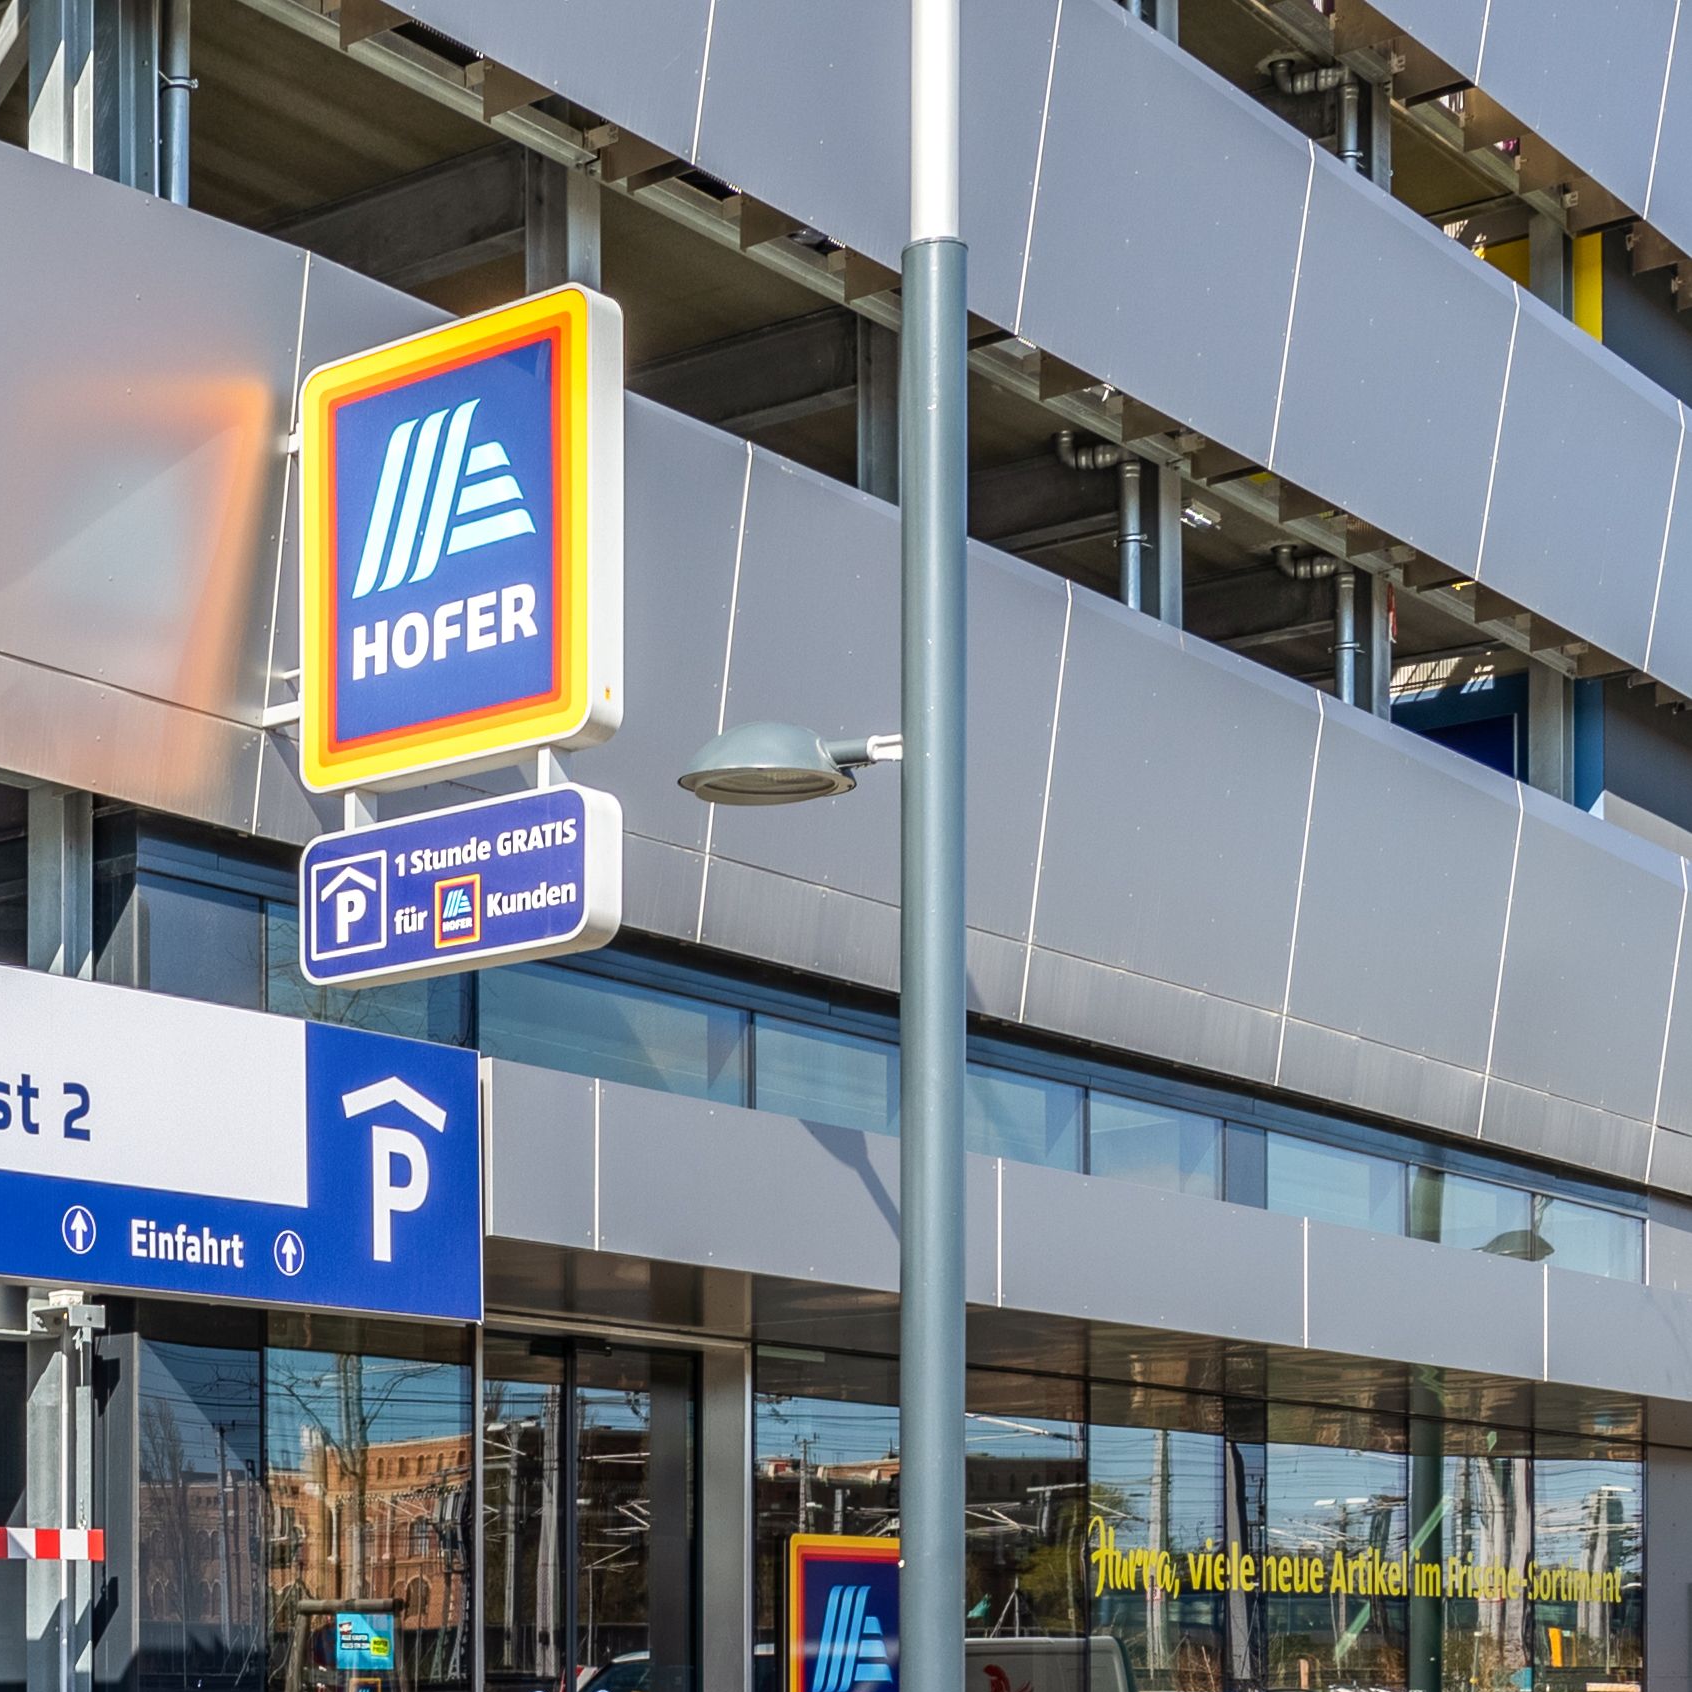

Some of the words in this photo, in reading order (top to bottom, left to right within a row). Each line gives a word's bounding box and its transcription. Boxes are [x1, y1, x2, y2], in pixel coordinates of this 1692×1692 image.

[352, 583, 539, 681] HOFER
[394, 853, 406, 877] 1
[410, 837, 491, 875] Stunde
[496, 817, 578, 858] GRATIS
[336, 888, 367, 944] P
[394, 906, 429, 935] für
[441, 917, 473, 933] HOFER
[486, 882, 577, 918] Kunden
[61, 1081, 92, 1142] 2
[371, 1125, 430, 1263] P
[130, 1217, 245, 1269] Einfahrt
[1088, 1515, 1181, 1600] Hurra,
[1187, 1537, 1255, 1592] viele
[1262, 1554, 1325, 1593] neue
[1330, 1546, 1408, 1597] Artikel
[1415, 1551, 1441, 1597] im
[1446, 1550, 1623, 1604] Frische-Sortiment
